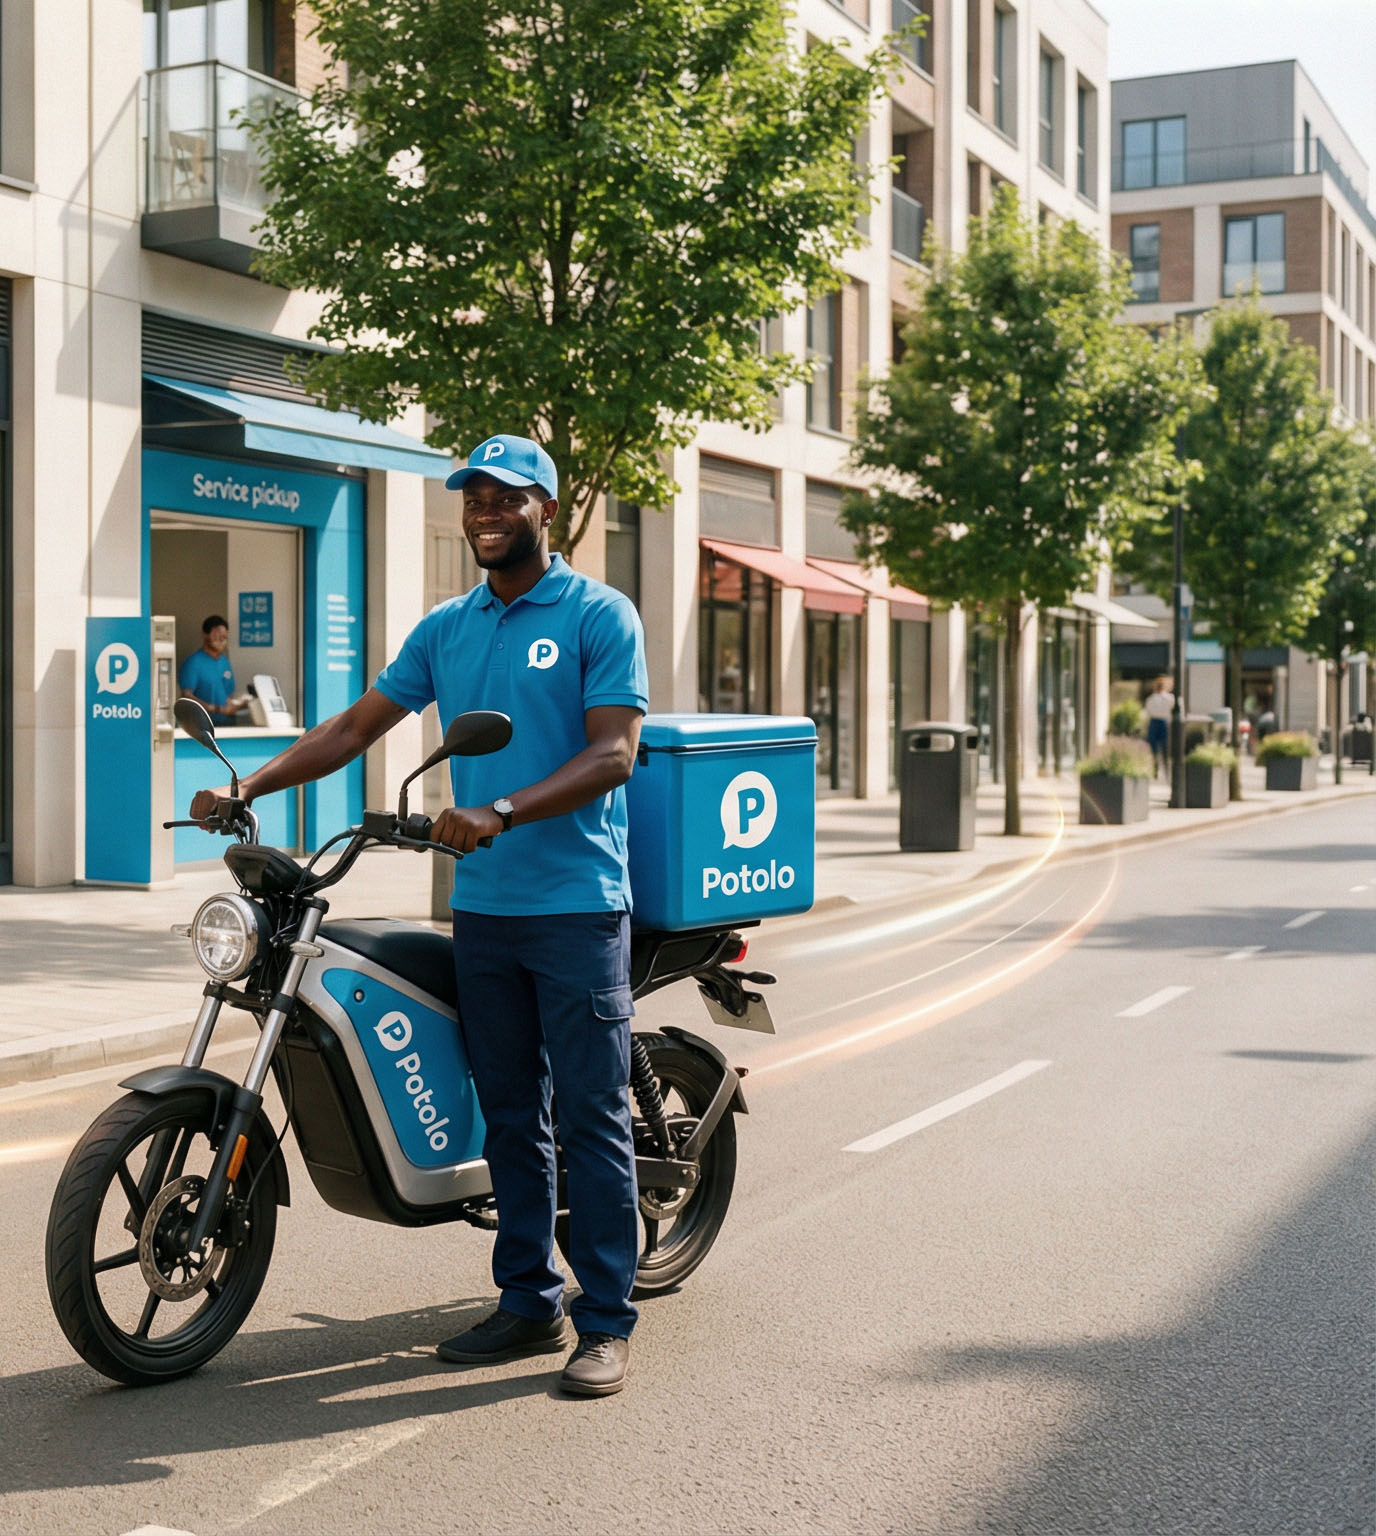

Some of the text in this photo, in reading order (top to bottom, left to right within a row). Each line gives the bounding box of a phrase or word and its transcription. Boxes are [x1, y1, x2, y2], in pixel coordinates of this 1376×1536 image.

[193, 473, 301, 513] Service pickup
[109, 654, 130, 684] P
[536, 643, 552, 663] P
[92, 703, 143, 719] Potolo
[737, 787, 766, 835] P
[702, 859, 795, 899] Potolo
[382, 1018, 450, 1151] P Potolo
